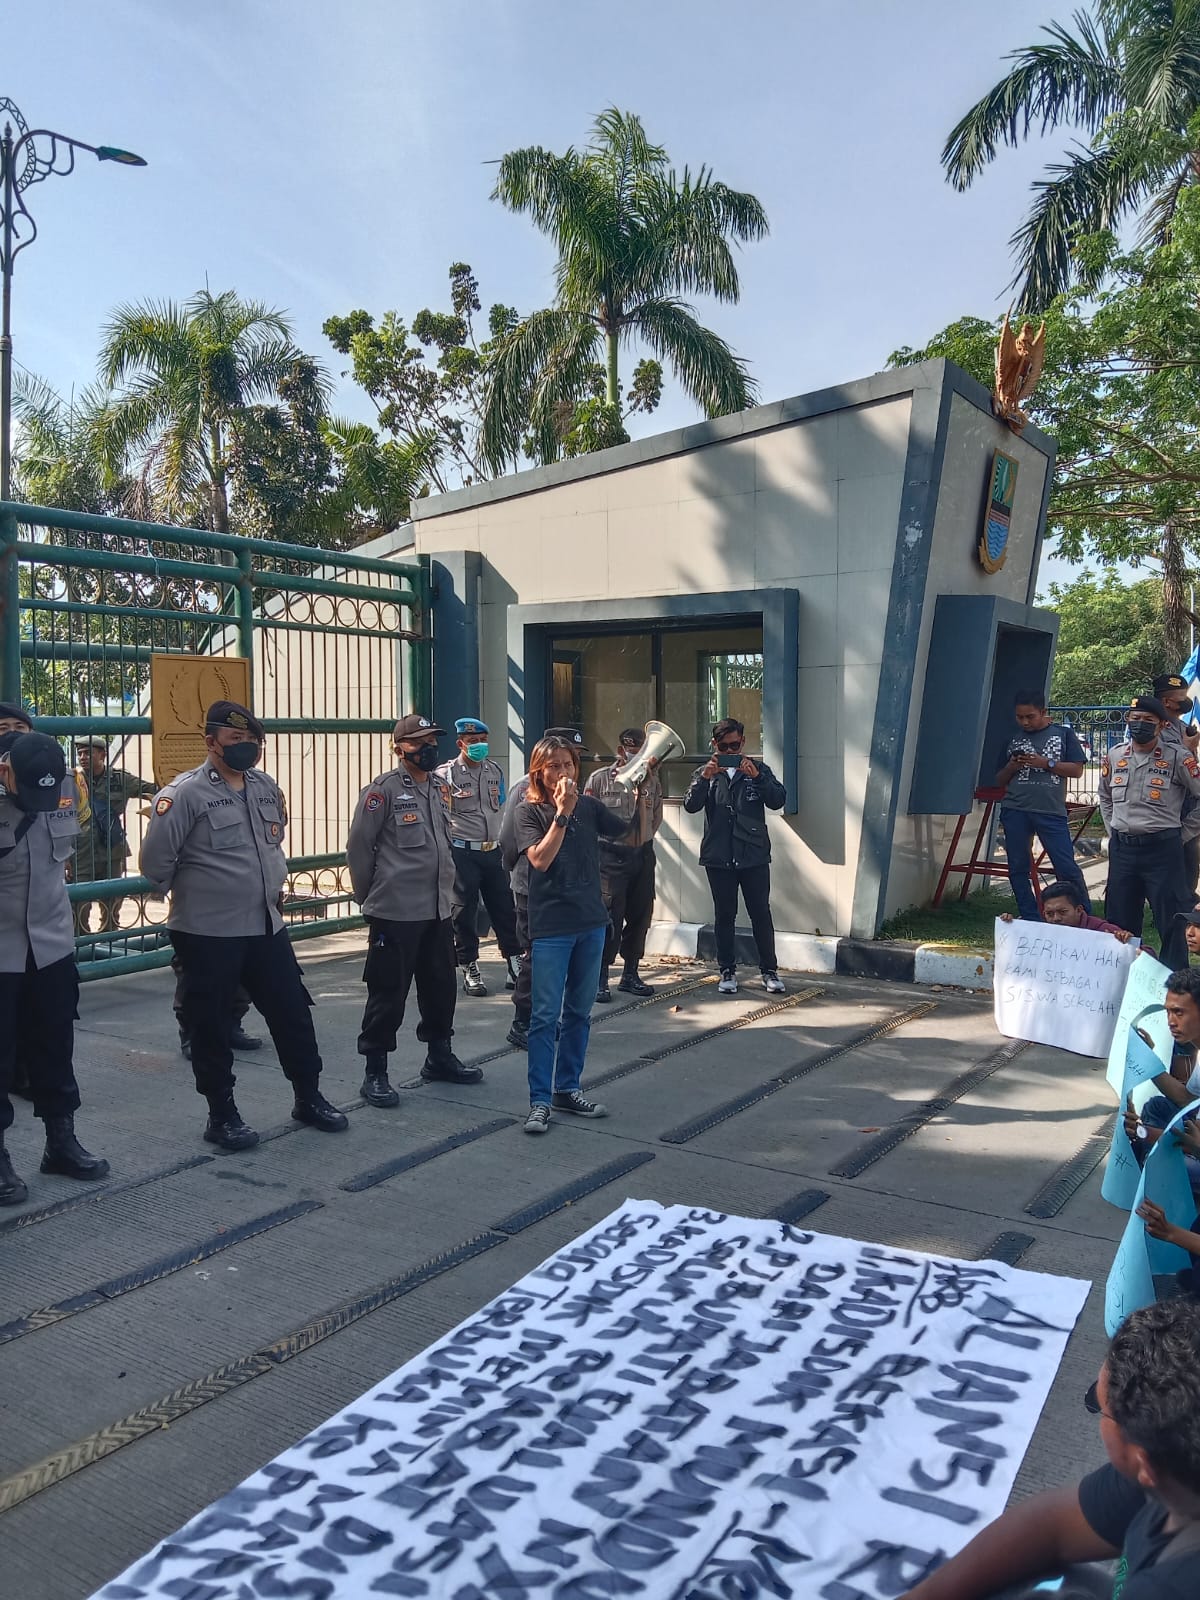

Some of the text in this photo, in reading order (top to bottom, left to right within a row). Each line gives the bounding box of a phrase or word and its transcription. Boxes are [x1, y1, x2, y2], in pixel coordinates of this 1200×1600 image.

[1015, 936, 1090, 961] BERIKAN
[1002, 985, 1059, 1005] SISWA
[1004, 963, 1100, 990] KAMI SEBAGAI
[920, 1262, 1006, 1313] ARB
[751, 1354, 930, 1501] BEKASI
[880, 1292, 1070, 1525] ALIANSI
[370, 1389, 633, 1598] EVALUASI
